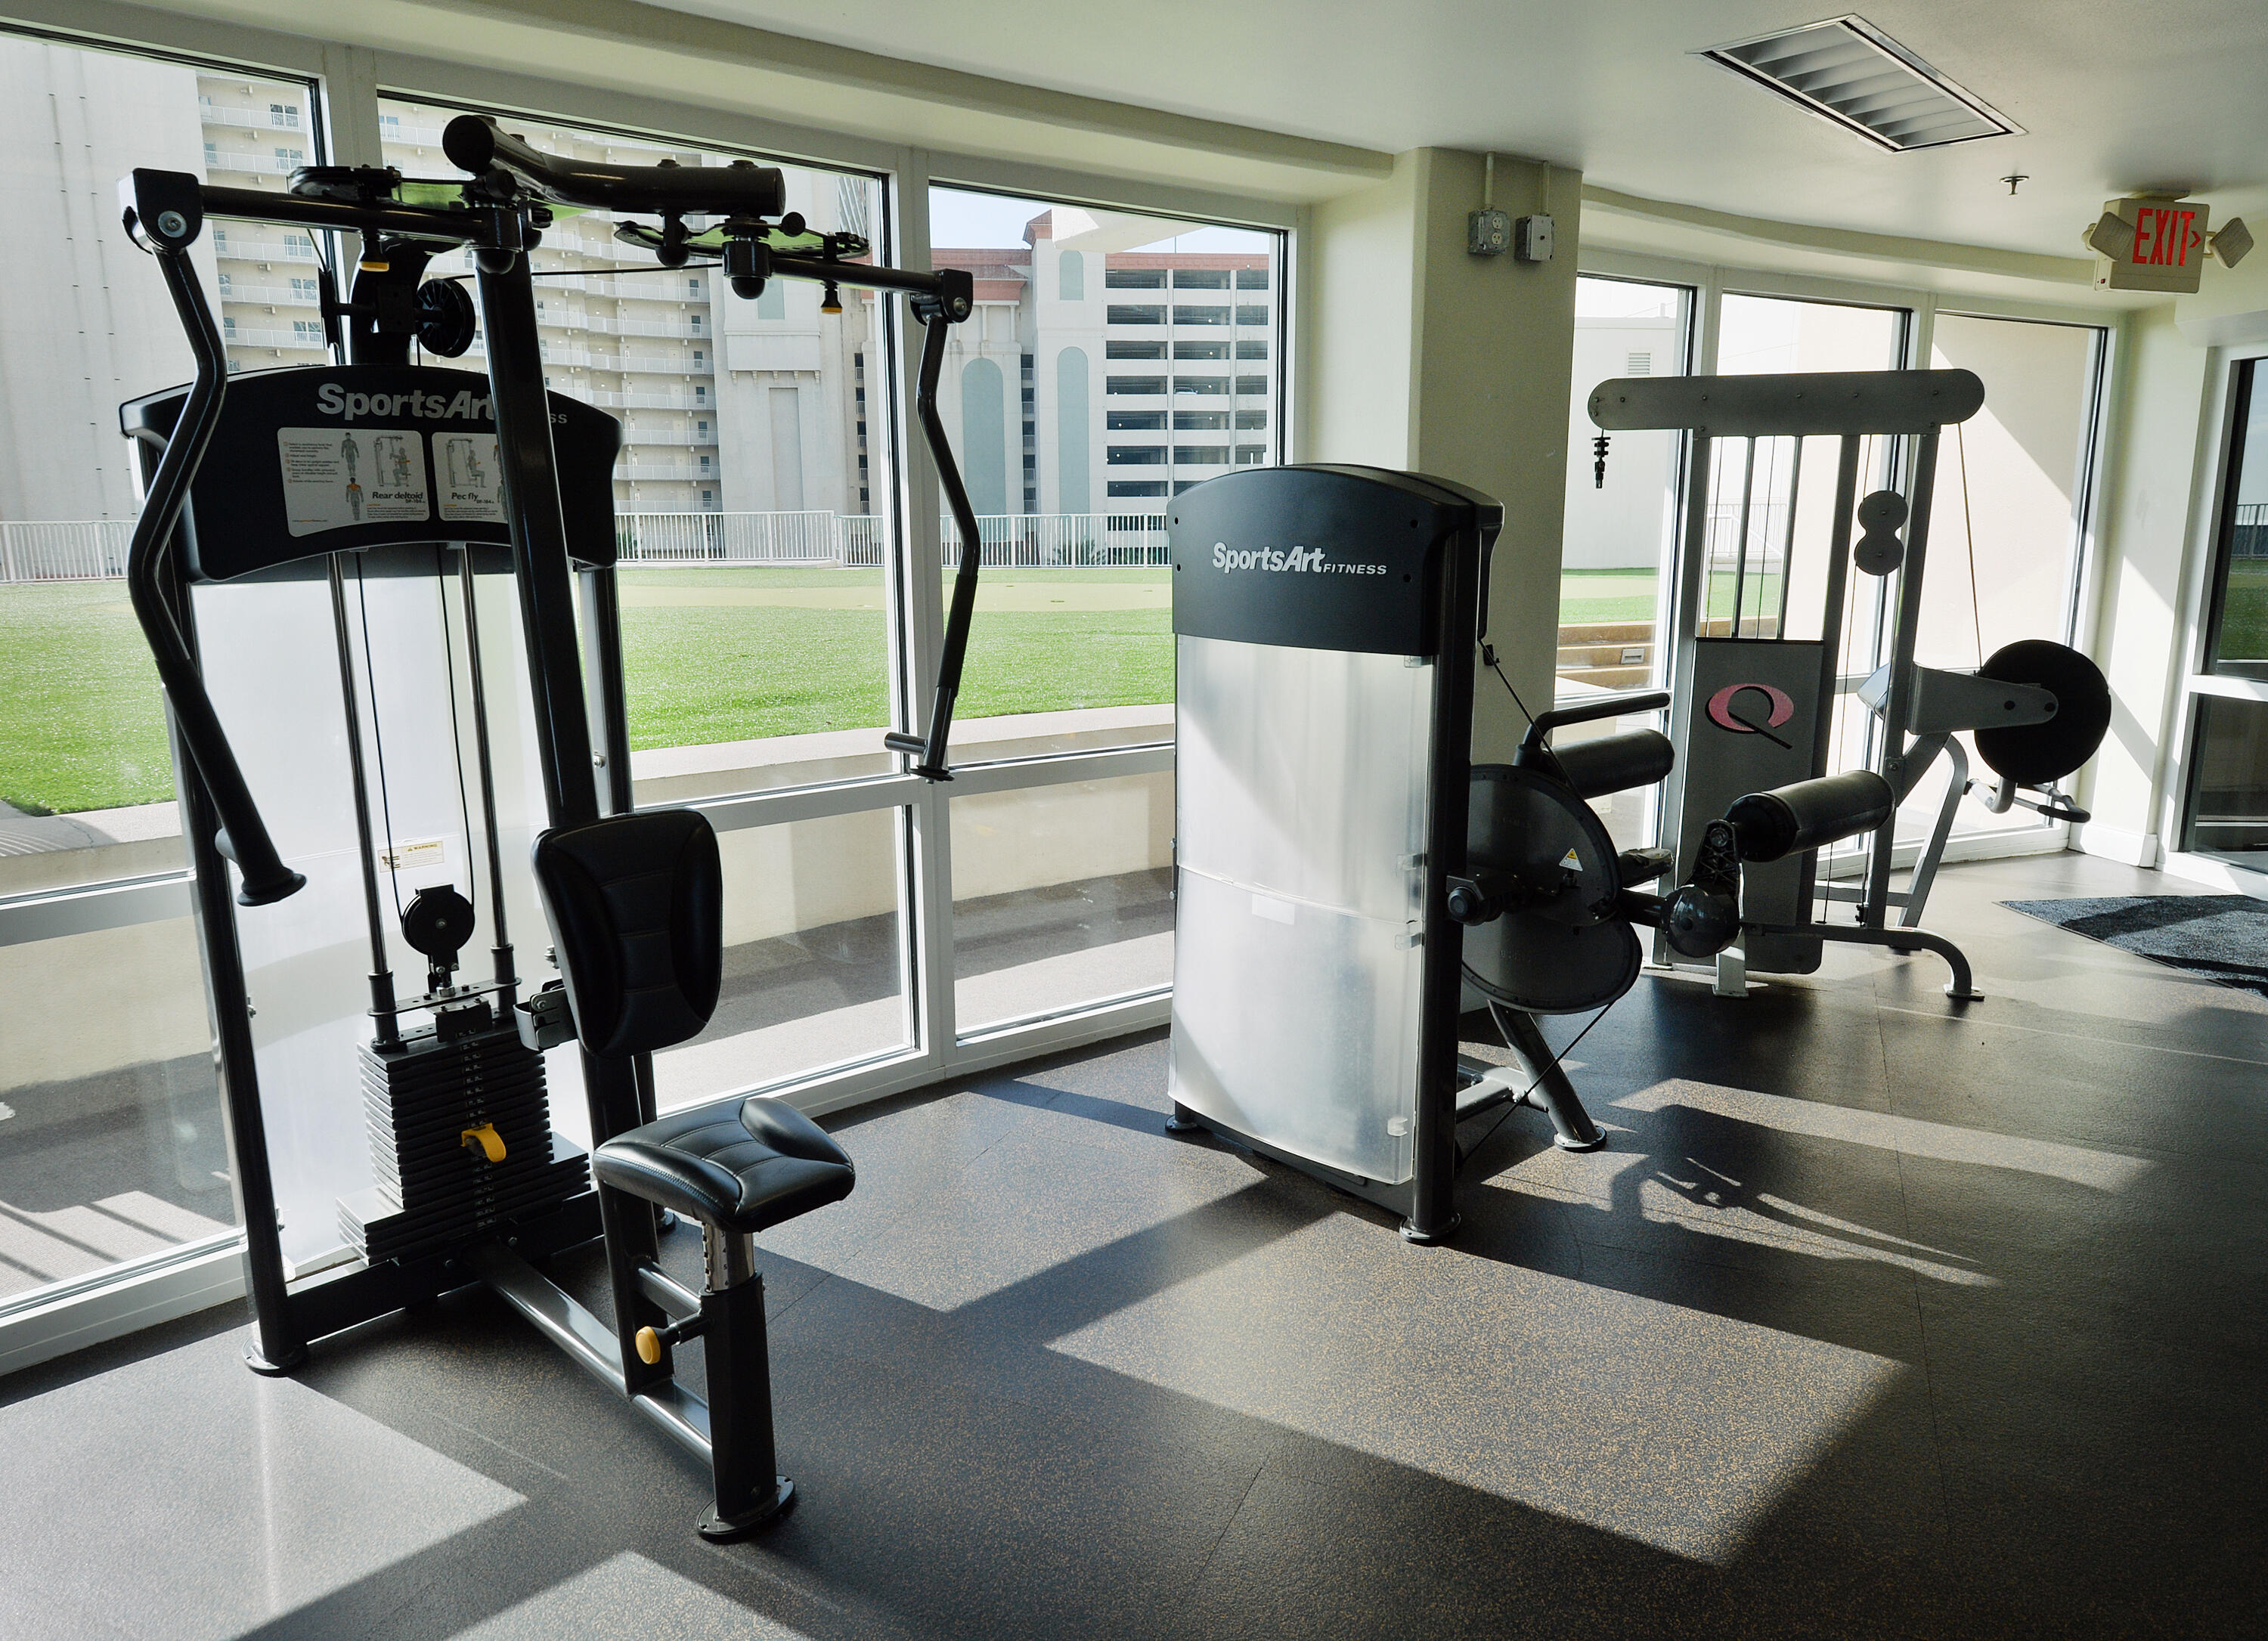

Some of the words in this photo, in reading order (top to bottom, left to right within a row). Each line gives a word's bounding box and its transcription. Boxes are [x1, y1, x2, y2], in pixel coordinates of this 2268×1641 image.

[2132, 207, 2195, 267] EXIT
[317, 382, 495, 421] SportsArt
[468, 492, 479, 502] fly
[1212, 541, 1326, 574] SportsArt
[1324, 563, 1387, 575] FITNESS
